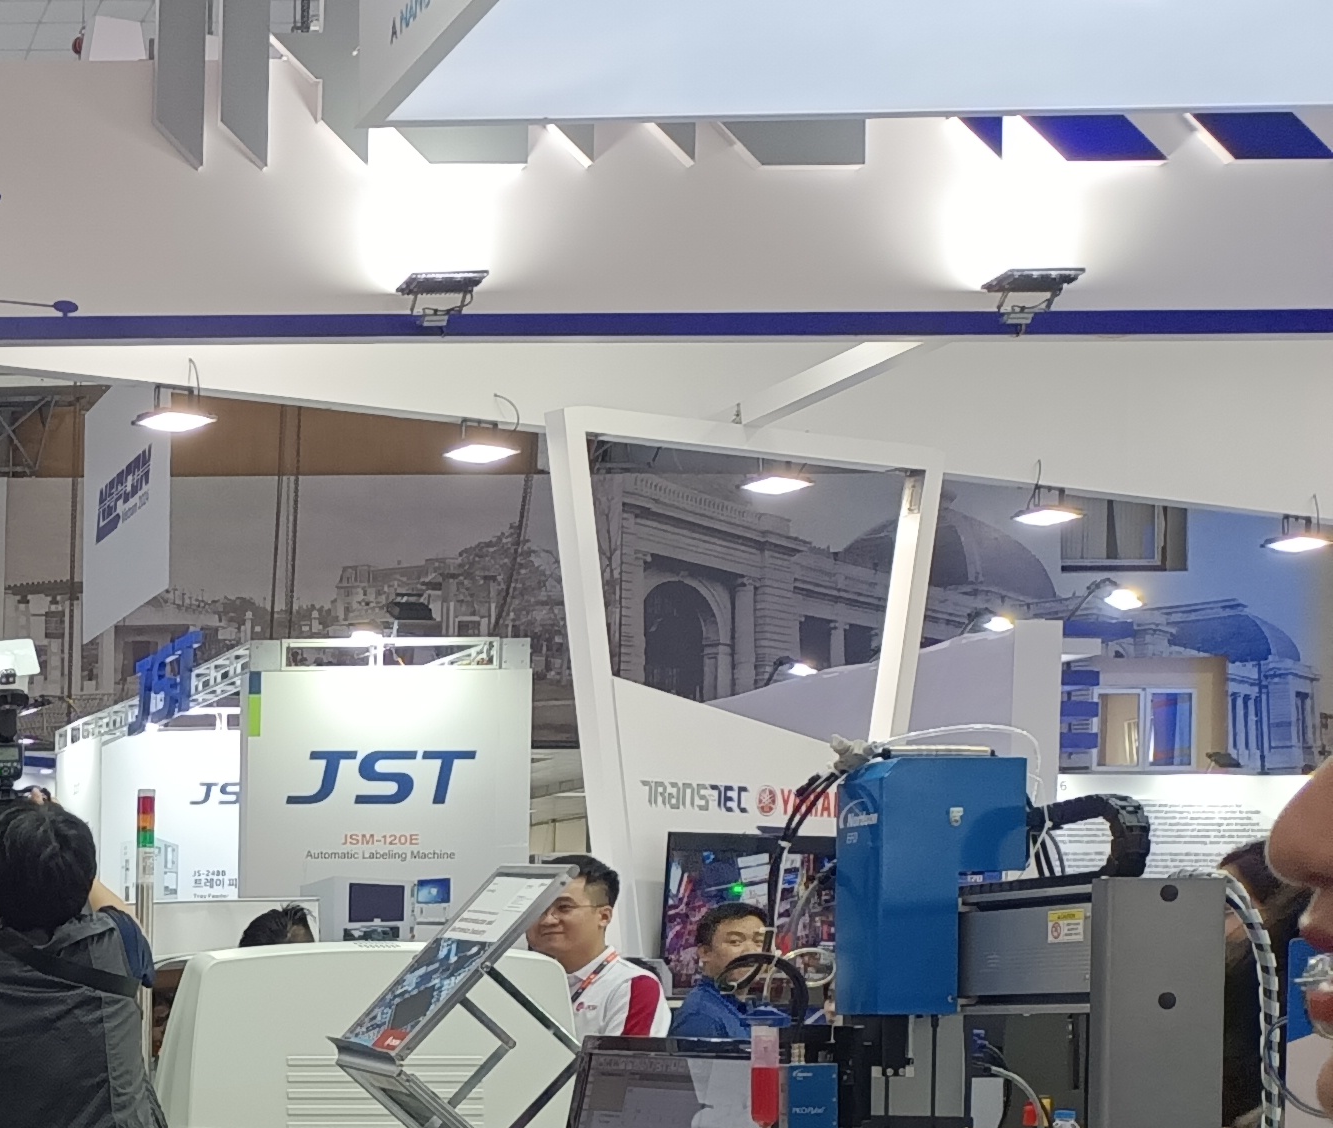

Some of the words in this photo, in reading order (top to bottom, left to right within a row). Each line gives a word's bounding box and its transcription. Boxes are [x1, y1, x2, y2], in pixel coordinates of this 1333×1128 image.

[285, 750, 477, 805] JST
[341, 833, 420, 846] JSM-120E
[305, 850, 359, 860] Automatic
[362, 850, 407, 862] Labeling
[410, 850, 456, 860] Machine
